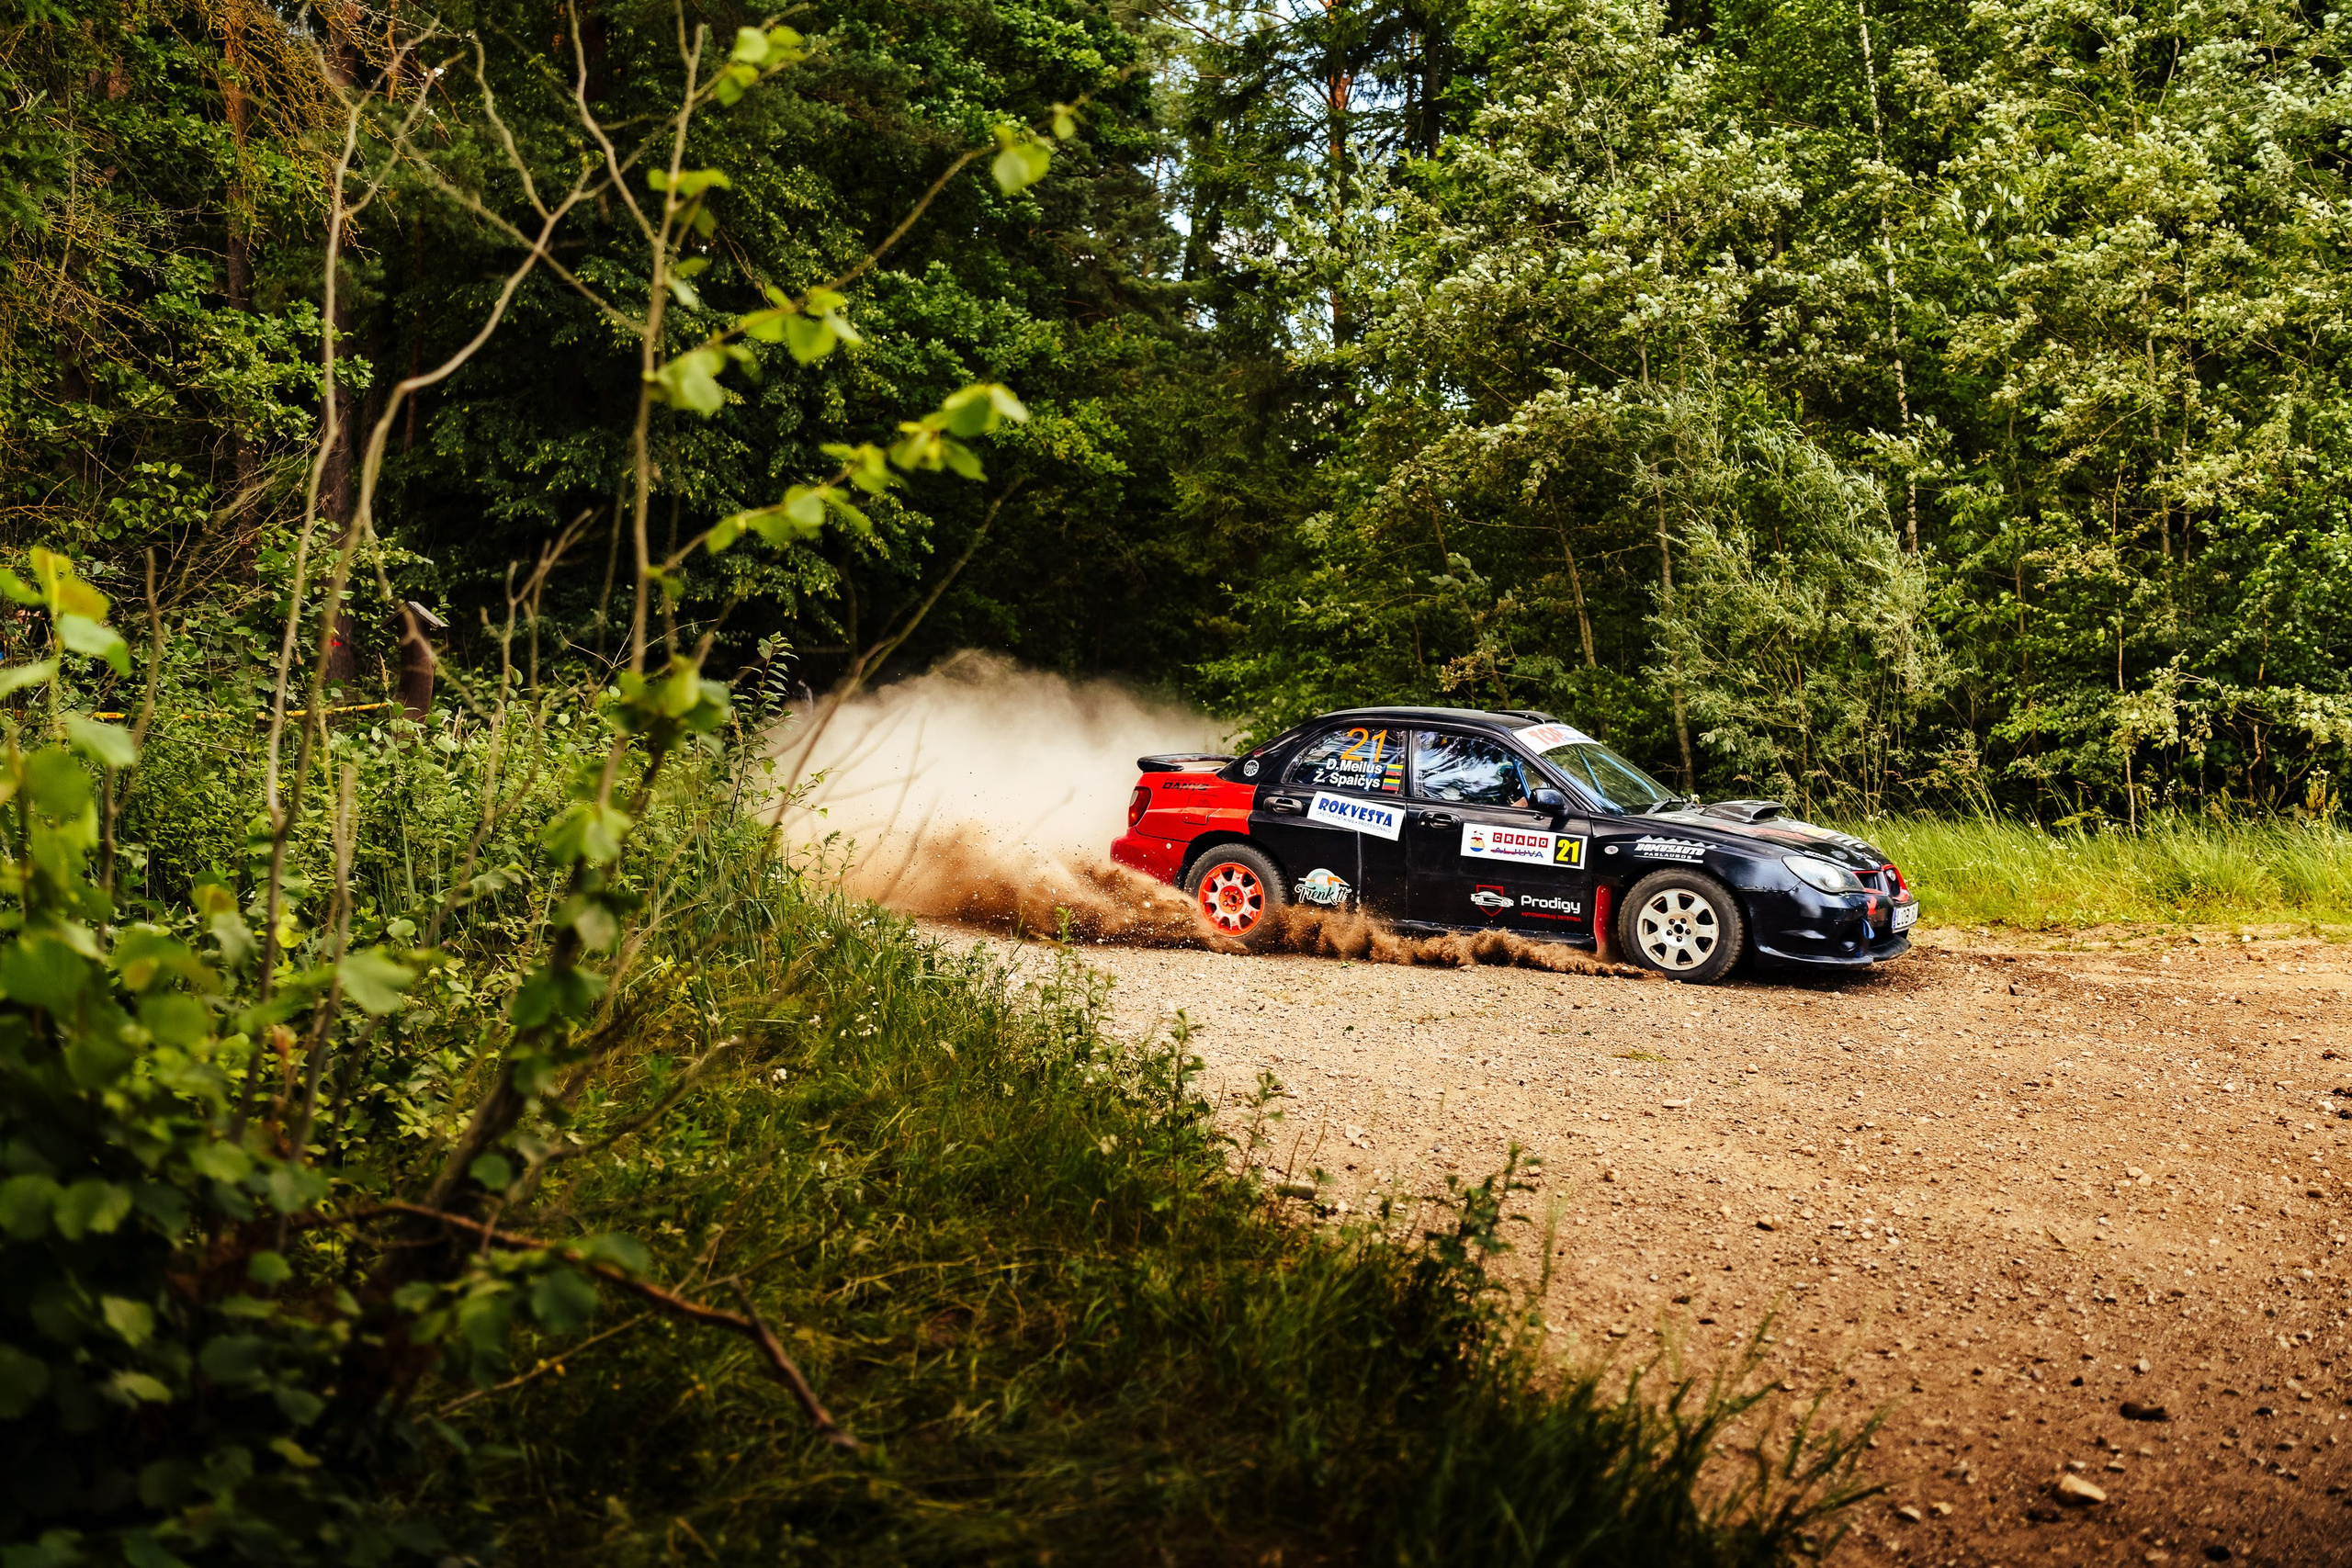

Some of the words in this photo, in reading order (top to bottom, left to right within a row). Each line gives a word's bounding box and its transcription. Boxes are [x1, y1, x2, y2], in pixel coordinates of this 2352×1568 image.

[1340, 727, 1387, 762] 21
[1326, 758, 1383, 774] D.Meilus
[1313, 768, 1326, 783] Ž.
[1329, 773, 1381, 791] Spaičys
[1317, 797, 1393, 827] ROKVESTA
[1493, 832, 1549, 848] CRAMO
[1634, 842, 1706, 855] DOMUSAUTO
[1492, 847, 1544, 858] ALJUVA
[1555, 839, 1580, 863] 21
[1521, 895, 1581, 914] Prodigy
